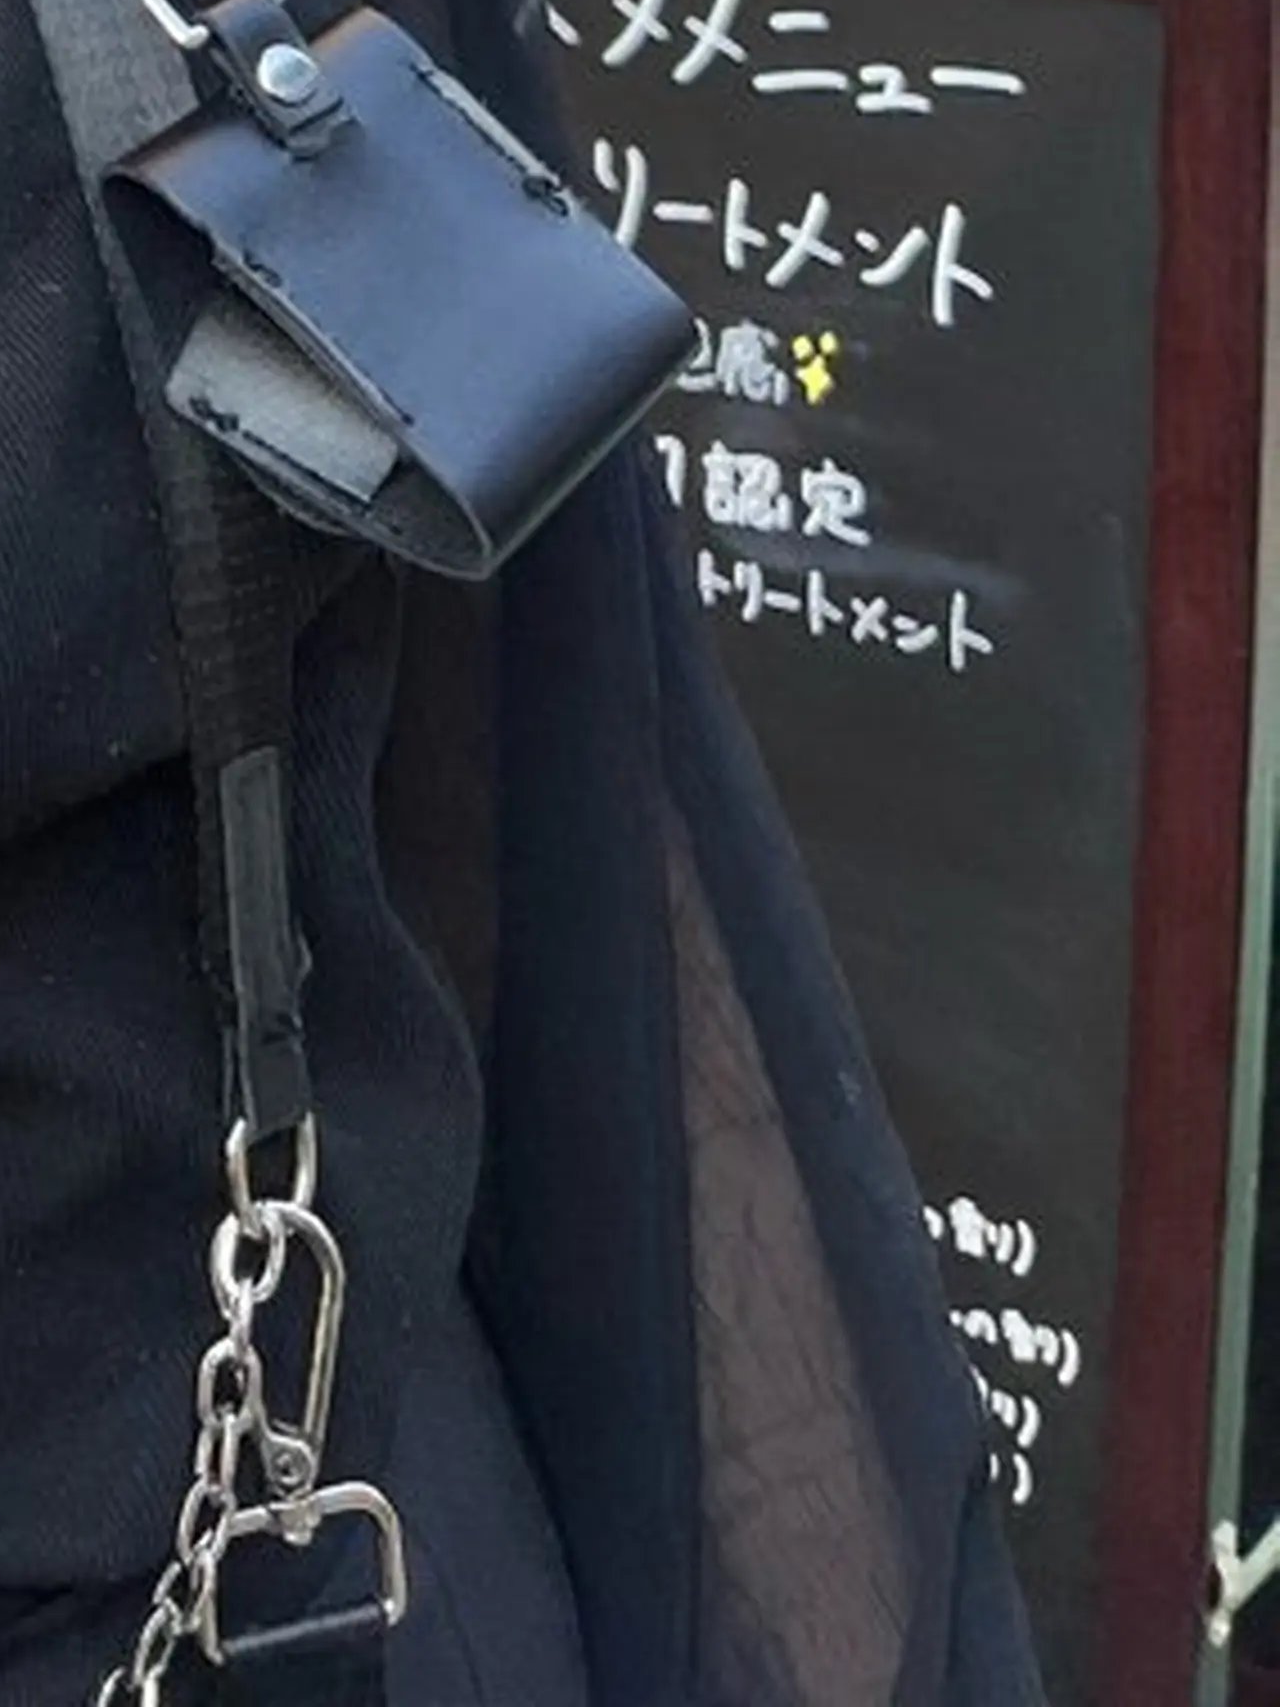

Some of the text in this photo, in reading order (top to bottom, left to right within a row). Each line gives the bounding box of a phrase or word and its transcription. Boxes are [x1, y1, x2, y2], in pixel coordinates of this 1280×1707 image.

[593, 136, 994, 327] リートメント
[697, 547, 994, 672] トリートメント
